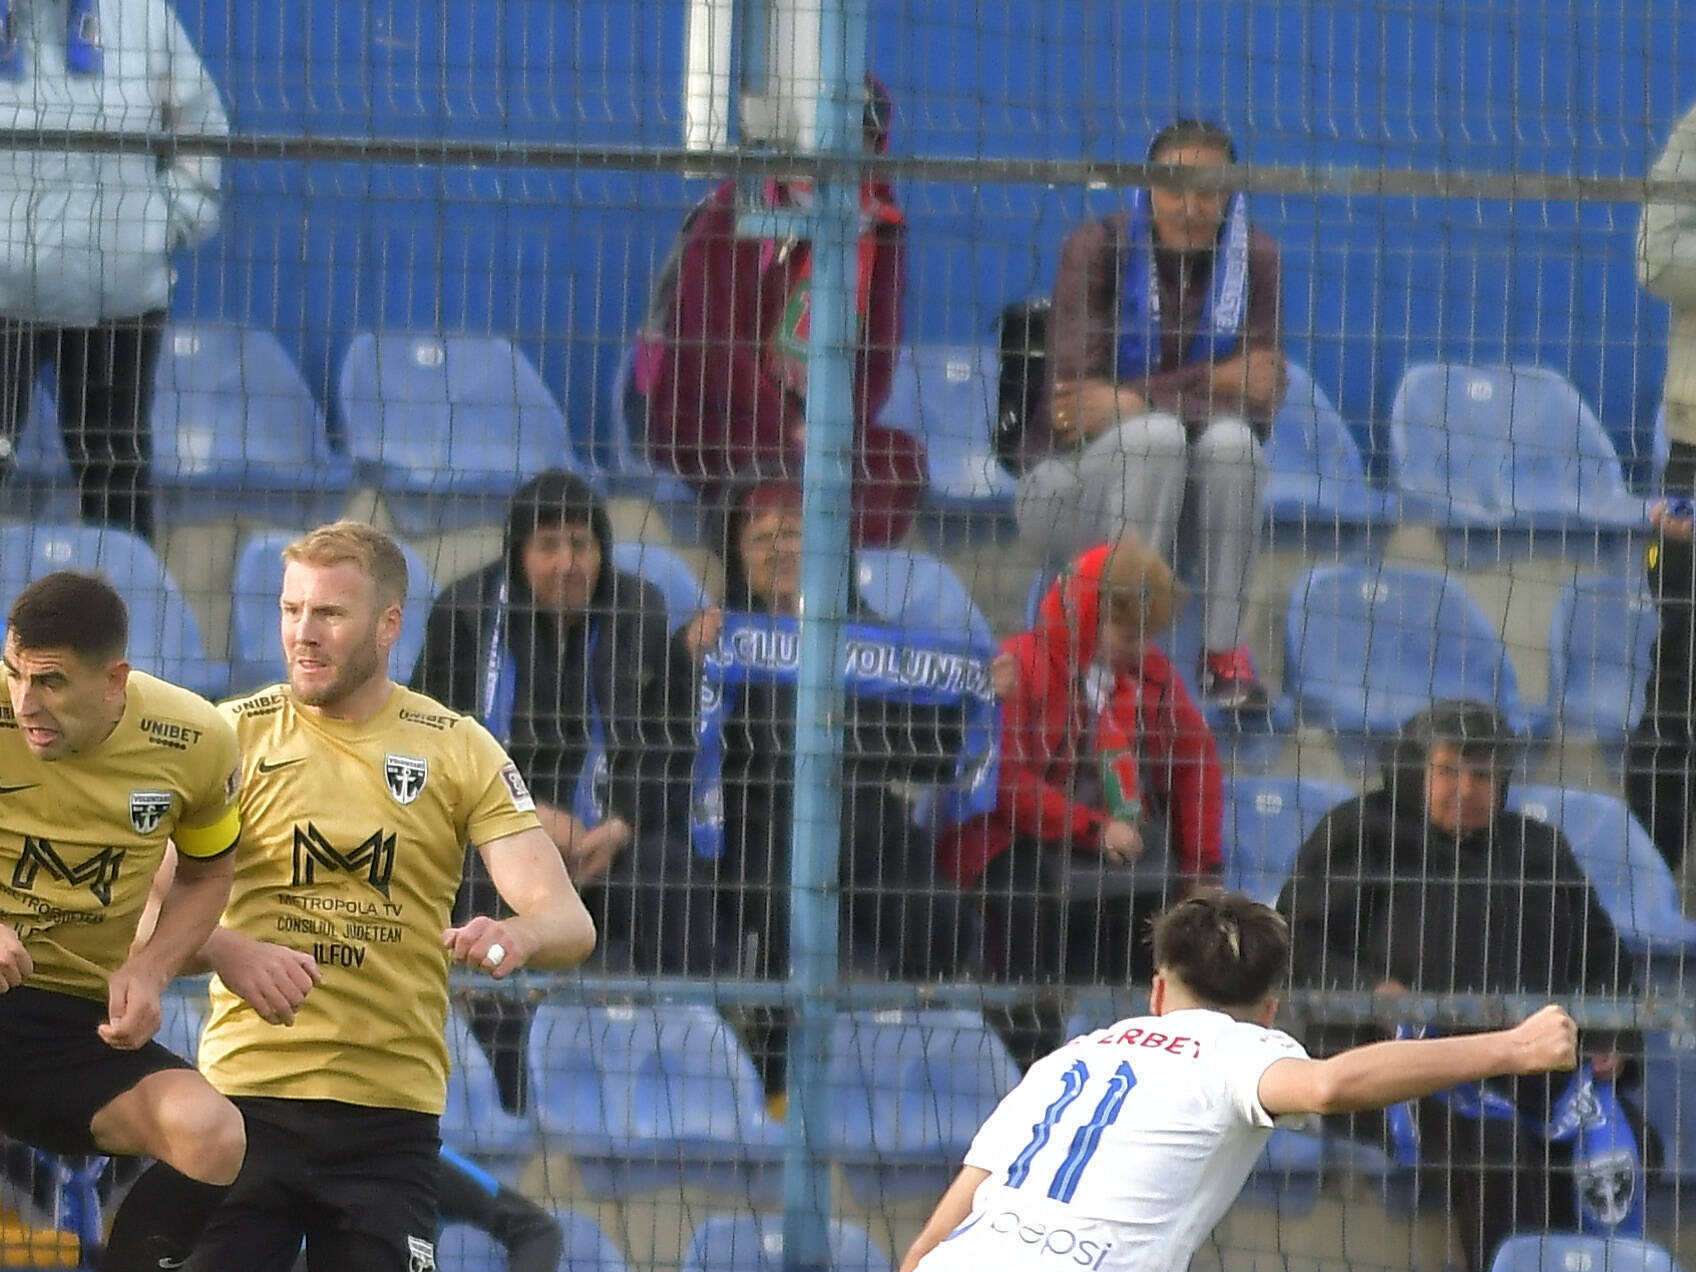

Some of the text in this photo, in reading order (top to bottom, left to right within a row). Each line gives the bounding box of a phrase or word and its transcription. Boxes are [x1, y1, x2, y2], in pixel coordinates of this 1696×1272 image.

[140, 718, 203, 745] UNIBET
[383, 903, 403, 917] TV
[277, 916, 403, 943] CONSILIUL JUDETEAN
[313, 943, 366, 968] ILFOV
[1004, 1059, 1138, 1204] 11
